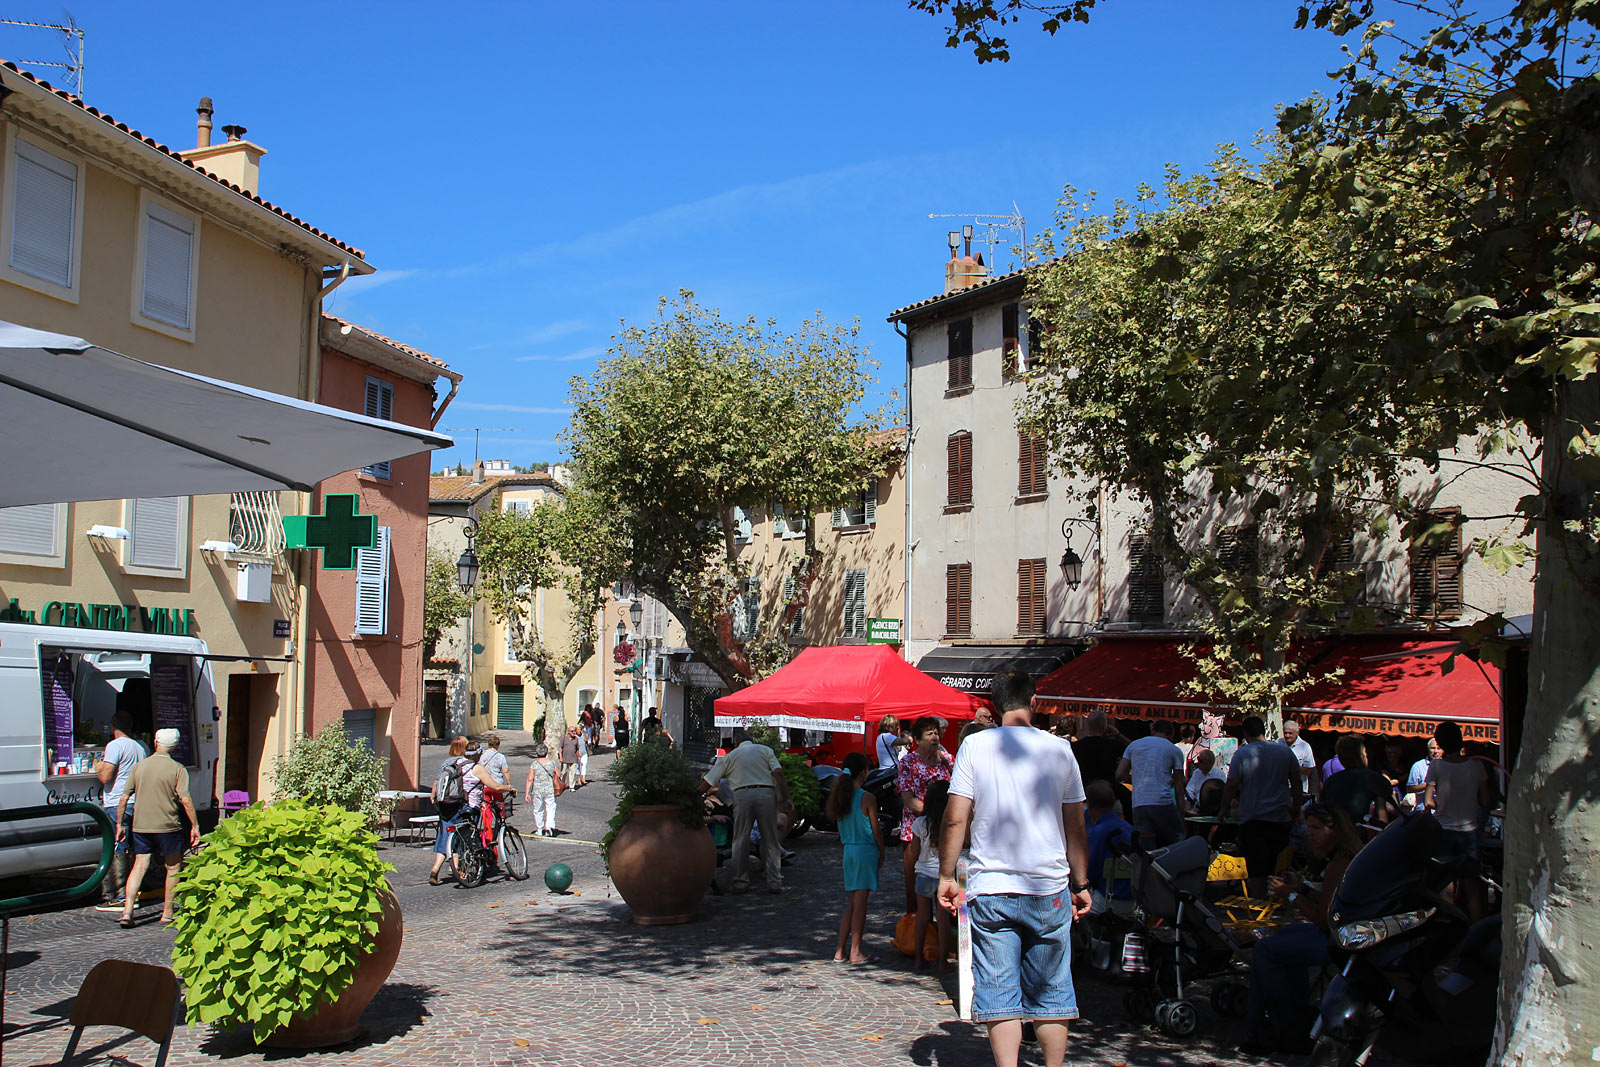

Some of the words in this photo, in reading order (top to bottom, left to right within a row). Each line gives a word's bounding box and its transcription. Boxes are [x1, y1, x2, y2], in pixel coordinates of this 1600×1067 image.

[41, 601, 136, 631] CENTRE
[140, 607, 195, 635] VILLE
[872, 621, 889, 629] AGENCE
[975, 678, 993, 689] COIF
[1063, 702, 1080, 713] LOU
[1116, 704, 1141, 716] VOUS
[1328, 716, 1377, 731] BOUDIN
[1380, 719, 1395, 732] ET
[1398, 720, 1498, 739] CHARARIE
[47, 789, 80, 805] Crêpe
